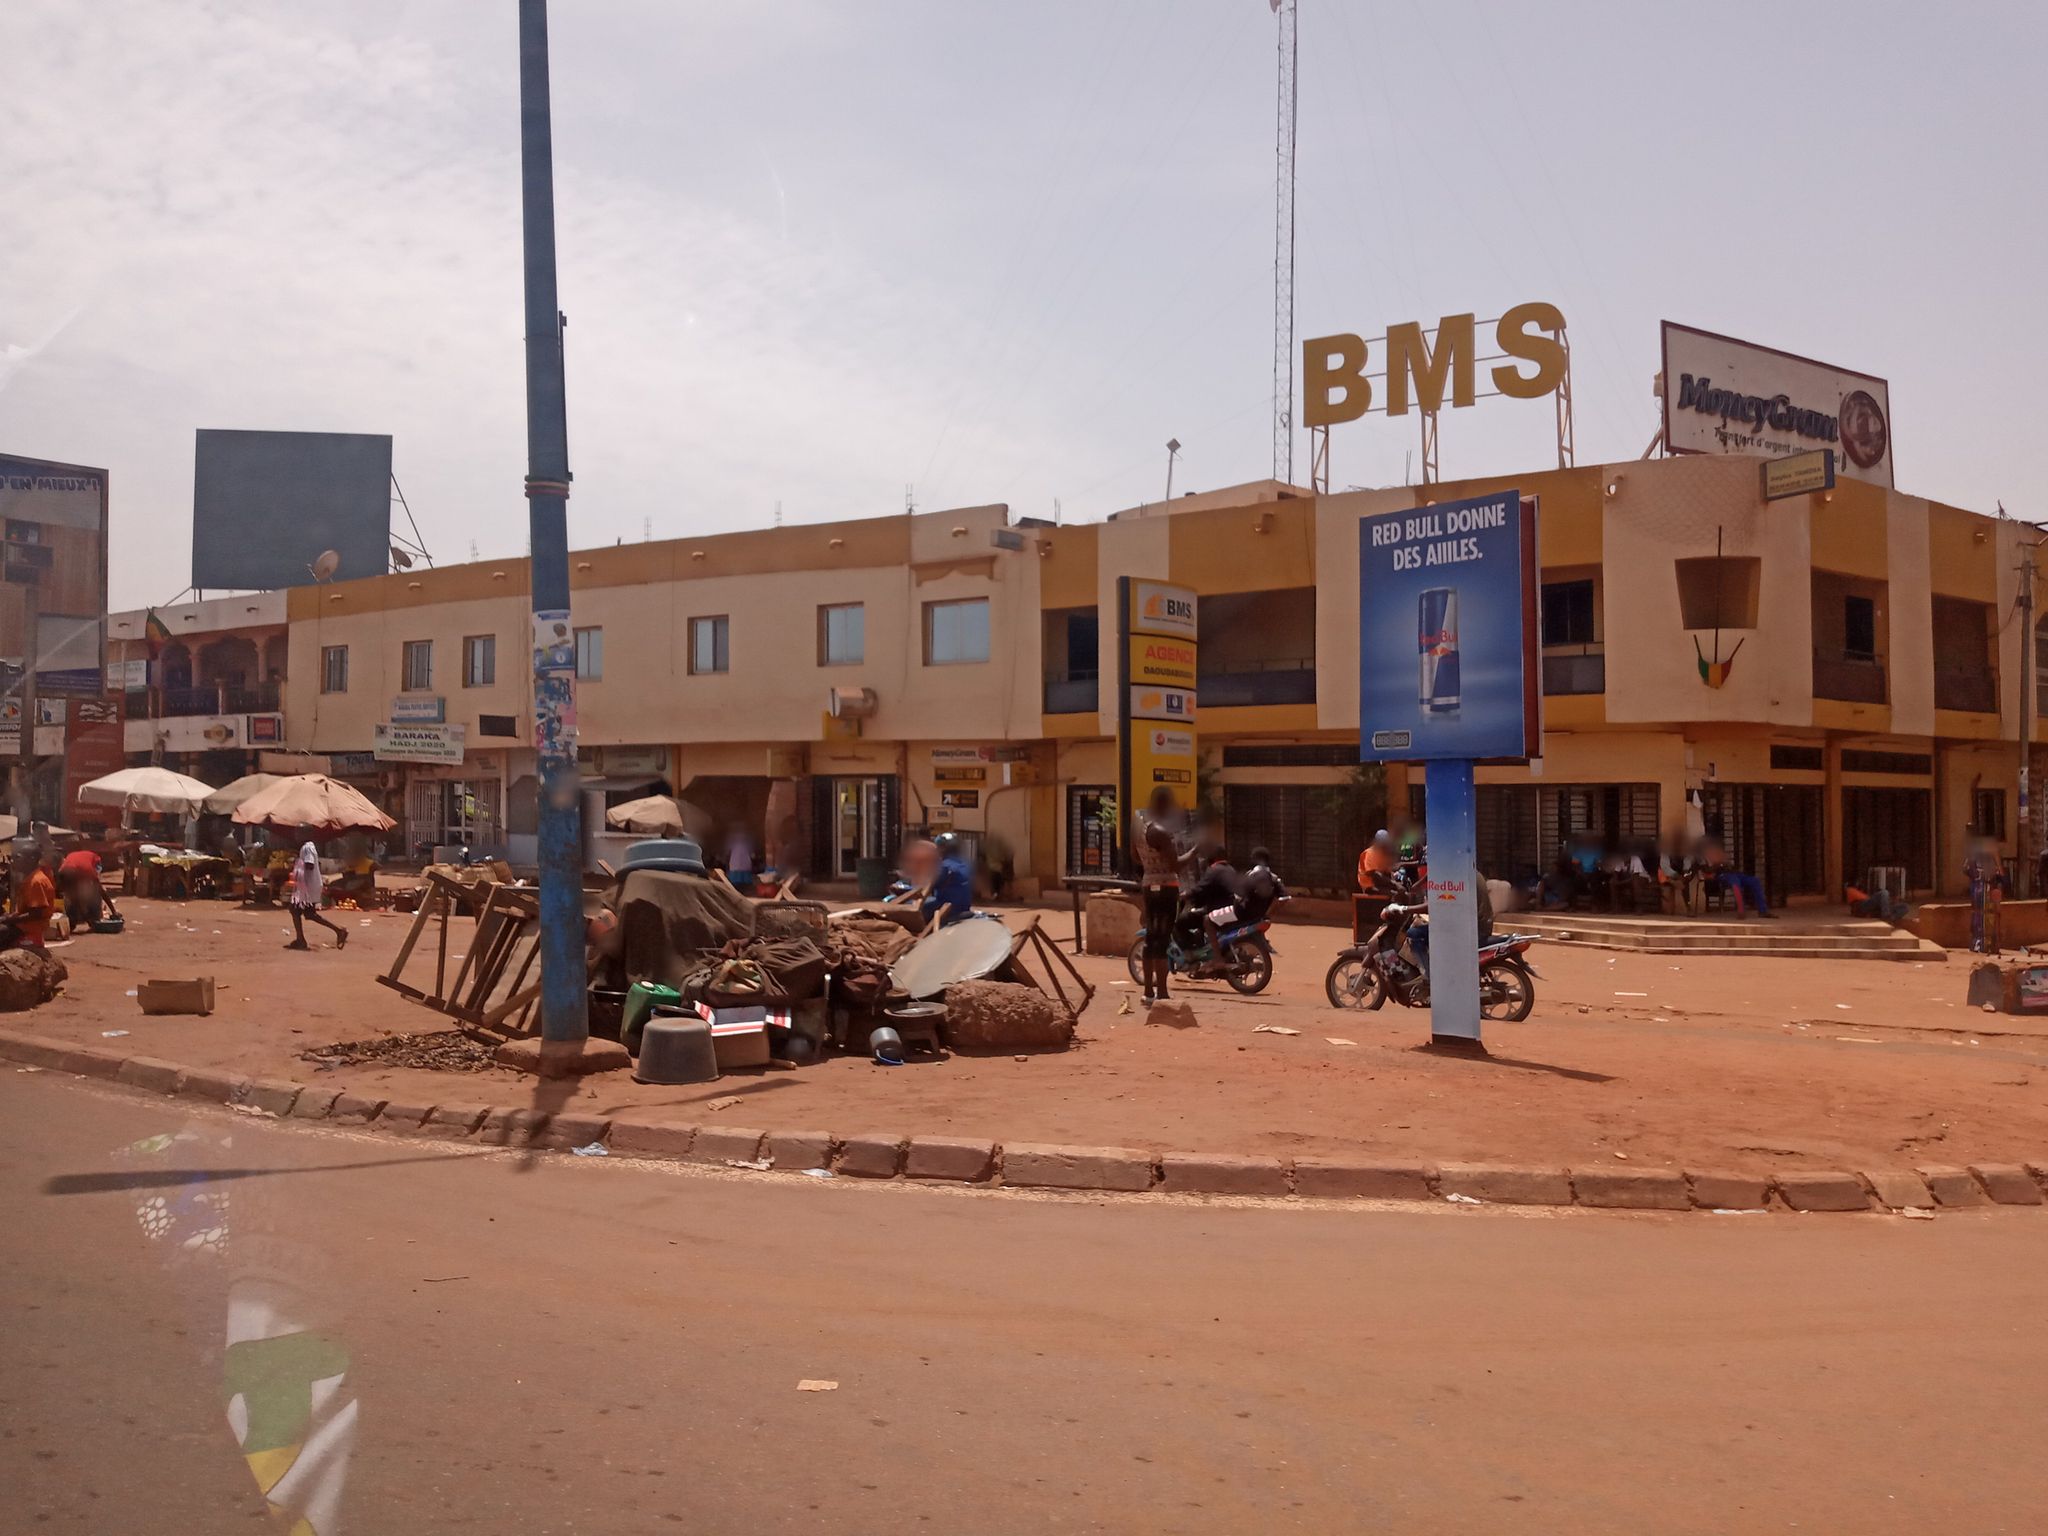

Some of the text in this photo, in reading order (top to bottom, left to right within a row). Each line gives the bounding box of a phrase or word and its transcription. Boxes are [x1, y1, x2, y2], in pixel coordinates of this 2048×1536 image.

[1303, 302, 1567, 428] BMS
[1677, 373, 1838, 442] MoneyGram
[1372, 503, 1506, 547] RED BULL DONNE
[1393, 546, 1422, 571] DES
[1167, 599, 1192, 619] BMS
[393, 732, 441, 741] BARAKA
[1447, 880, 1465, 893] Bull
